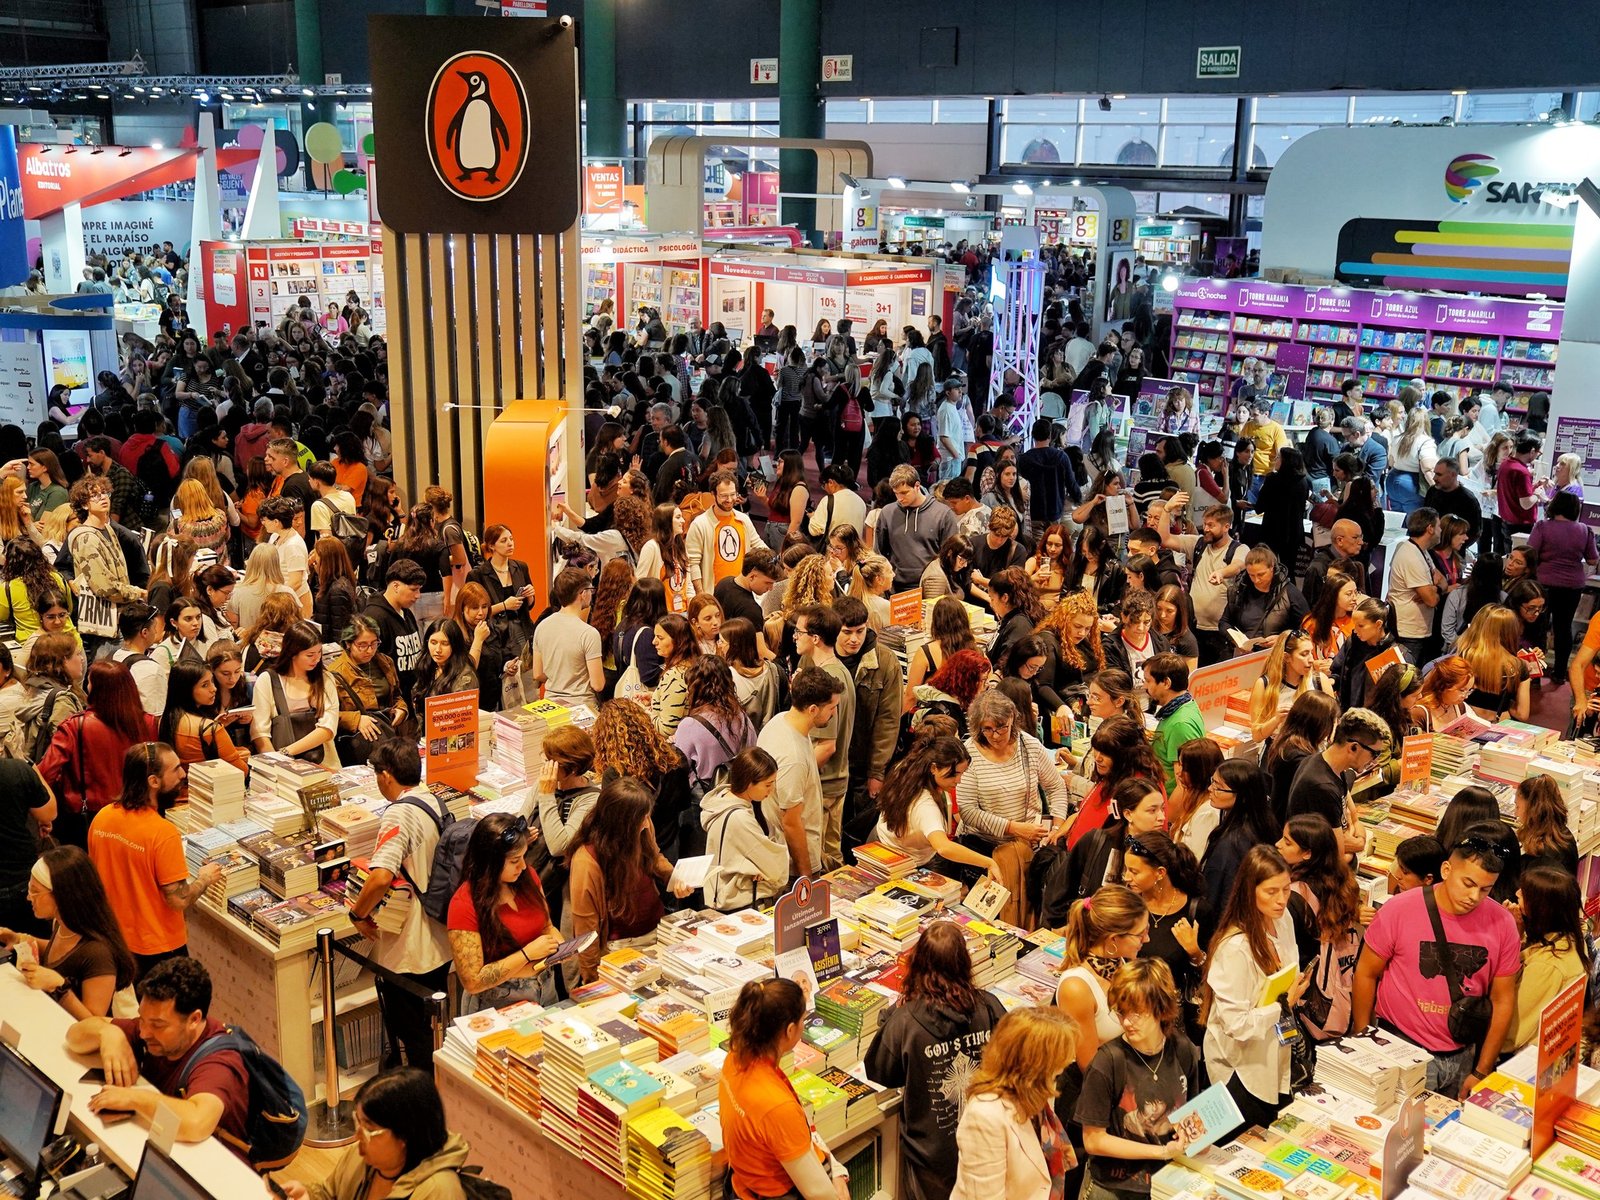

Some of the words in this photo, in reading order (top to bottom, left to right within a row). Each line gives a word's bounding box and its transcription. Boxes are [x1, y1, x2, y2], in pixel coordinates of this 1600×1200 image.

[1201, 53, 1237, 66] SALIDA
[25, 157, 71, 178] Albatros
[590, 173, 620, 182] VENTAS
[37, 181, 61, 191] EDITORIAL
[110, 218, 154, 230] IMAGINÉ
[91, 234, 102, 243] EL
[105, 231, 149, 243] PARAÍSO
[850, 236, 878, 249] galerna
[612, 246, 648, 254] DIDÁCTICA
[658, 242, 698, 252] PSICOLOGÍA
[254, 267, 264, 278] N
[723, 264, 766, 276] Noveduc.com
[257, 288, 264, 297] 3
[1177, 290, 1198, 298] Buenas
[1206, 292, 1227, 300] noches
[1249, 292, 1265, 300] TORRE
[1266, 294, 1289, 303] NARANJA
[820, 297, 836, 308] 10%
[876, 303, 892, 314] 3+1
[1320, 298, 1336, 306] TORRE
[1338, 299, 1350, 308] ROJA
[1386, 303, 1404, 312] TORRE
[1404, 305, 1418, 314] AZUL
[1448, 308, 1466, 317] TORRE
[1467, 310, 1495, 319] AMARILLA
[1194, 676, 1239, 698] Historias
[428, 698, 454, 706] Promoción
[454, 694, 476, 702] exclusiva
[1214, 695, 1228, 708] en
[791, 906, 815, 920] Últimos
[784, 910, 823, 932] lanzamientos
[814, 954, 840, 972] ASISTENTA
[924, 1037, 961, 1058] GOD'S
[1490, 1146, 1511, 1164] LUZ
